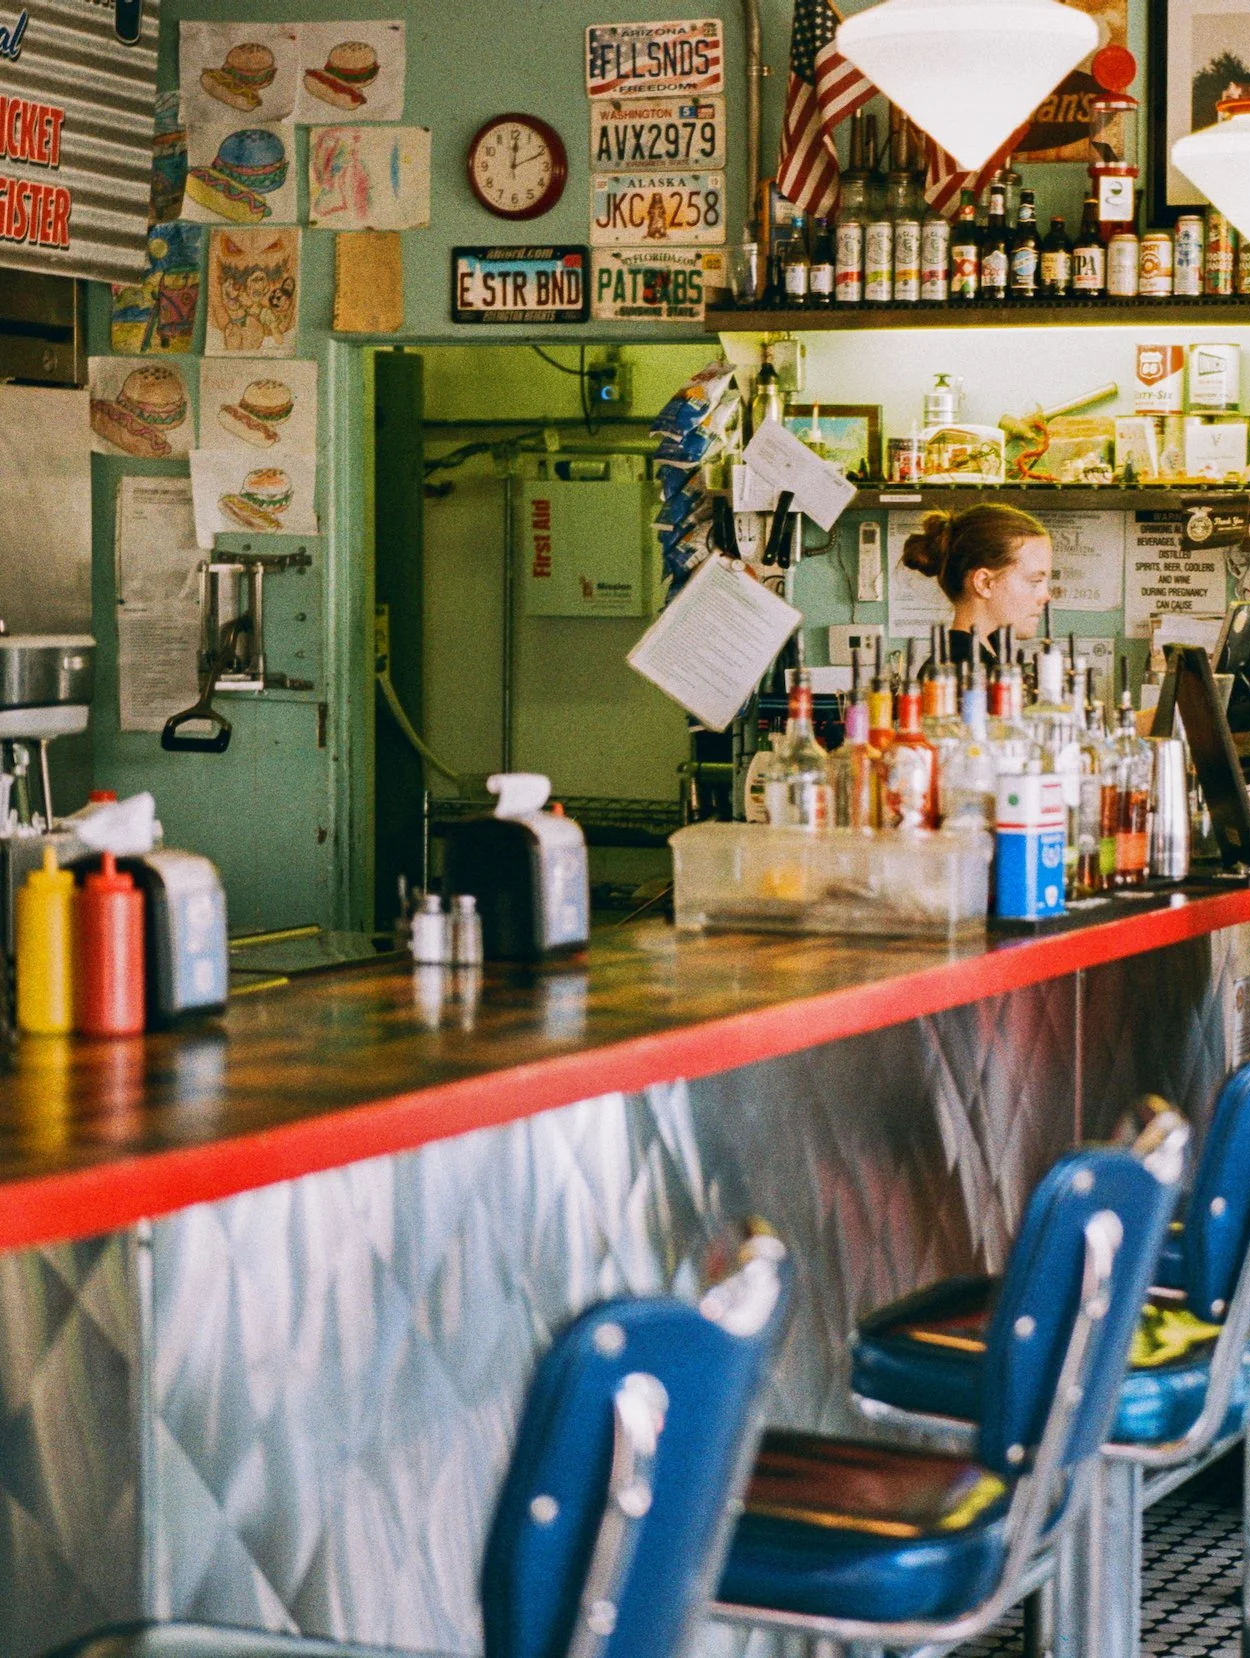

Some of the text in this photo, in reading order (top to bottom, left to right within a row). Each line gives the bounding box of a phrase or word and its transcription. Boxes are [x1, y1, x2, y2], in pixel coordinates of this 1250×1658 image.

[621, 27, 687, 37] ARIZONA
[600, 39, 710, 80] FLLSNDS
[619, 82, 691, 92] FREEDOM
[601, 108, 672, 120] WASHINGTON
[597, 122, 715, 161] AVX2979
[628, 178, 686, 188] ALASKA
[595, 190, 719, 228] JKC 258
[482, 271, 527, 307] STR
[536, 269, 580, 305] BND
[1137, 537, 1177, 547] BEVERAGES,
[1159, 550, 1191, 559] DISTILLED
[1184, 562, 1215, 573] COOLERS
[1158, 575, 1191, 584] AND WINE
[1141, 587, 1208, 597] DURING PREGNANCY
[1156, 600, 1192, 610] CAN CAUSE
